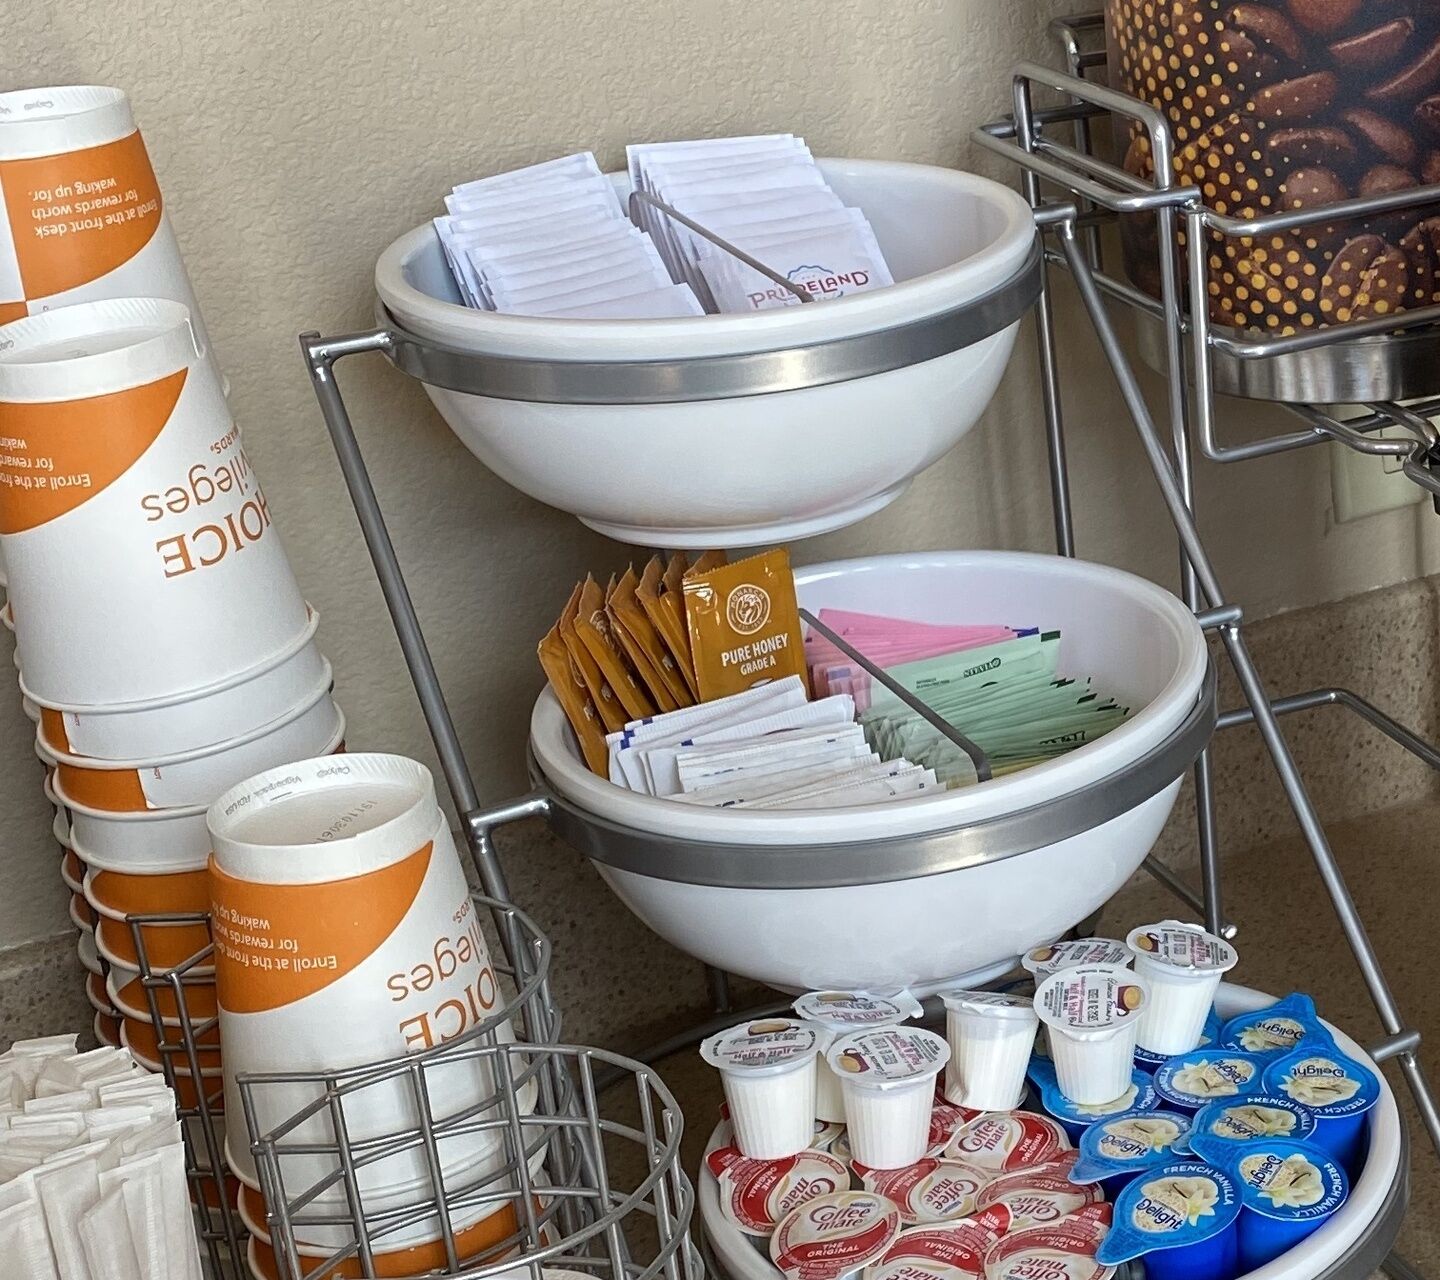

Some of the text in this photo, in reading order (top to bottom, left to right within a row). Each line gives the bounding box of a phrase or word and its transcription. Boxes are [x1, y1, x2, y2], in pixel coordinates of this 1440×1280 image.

[28, 177, 117, 202] waking up for.
[31, 189, 138, 220] for rewards worth
[105, 213, 124, 225] the
[125, 210, 136, 221] at
[35, 224, 68, 240] desk
[71, 218, 104, 233] front
[35, 457, 54, 472] for
[14, 475, 32, 490] the
[33, 476, 47, 488] at
[50, 473, 92, 491] Enroll
[156, 482, 273, 578] HOICE
[721, 633, 789, 666] PURE HONEY
[740, 655, 777, 676] GRADE A
[230, 909, 271, 931] waking
[229, 929, 274, 950] rewards
[278, 939, 298, 953] for
[225, 946, 249, 967] front
[252, 955, 272, 971] the
[275, 958, 289, 970] at
[293, 954, 337, 972] Enroll
[399, 958, 498, 1053] OICE
[1292, 1064, 1346, 1079] Delight
[1324, 1097, 1367, 1114] FRENCH
[957, 1119, 1001, 1153] Coffee
[983, 1124, 1009, 1152] mate
[1019, 1137, 1033, 1153] THE
[1021, 1132, 1044, 1163] ORIGINAL
[1100, 1134, 1149, 1157] Delight
[1248, 1154, 1284, 1189] Delight
[747, 1166, 778, 1199] ORIGINAL
[763, 1174, 777, 1192] THE
[923, 1178, 952, 1204] mate
[1163, 1165, 1235, 1206] FRENCH VANILLA
[1291, 1162, 1343, 1218] FRENCH VANILLA
[780, 1176, 810, 1210] mate
[933, 1178, 980, 1211] Coffee
[809, 1205, 871, 1224] Coffee
[1135, 1198, 1184, 1230] Delight
[816, 1217, 864, 1231] mate
[807, 1244, 860, 1258] ORIGINAL
[822, 1241, 845, 1251] THE
[924, 1241, 971, 1261] ORIGINAL
[1035, 1236, 1086, 1249] ORIGINAL
[1048, 1241, 1069, 1250] THE
[932, 1249, 952, 1261] THE
[1020, 1255, 1068, 1271] mate
